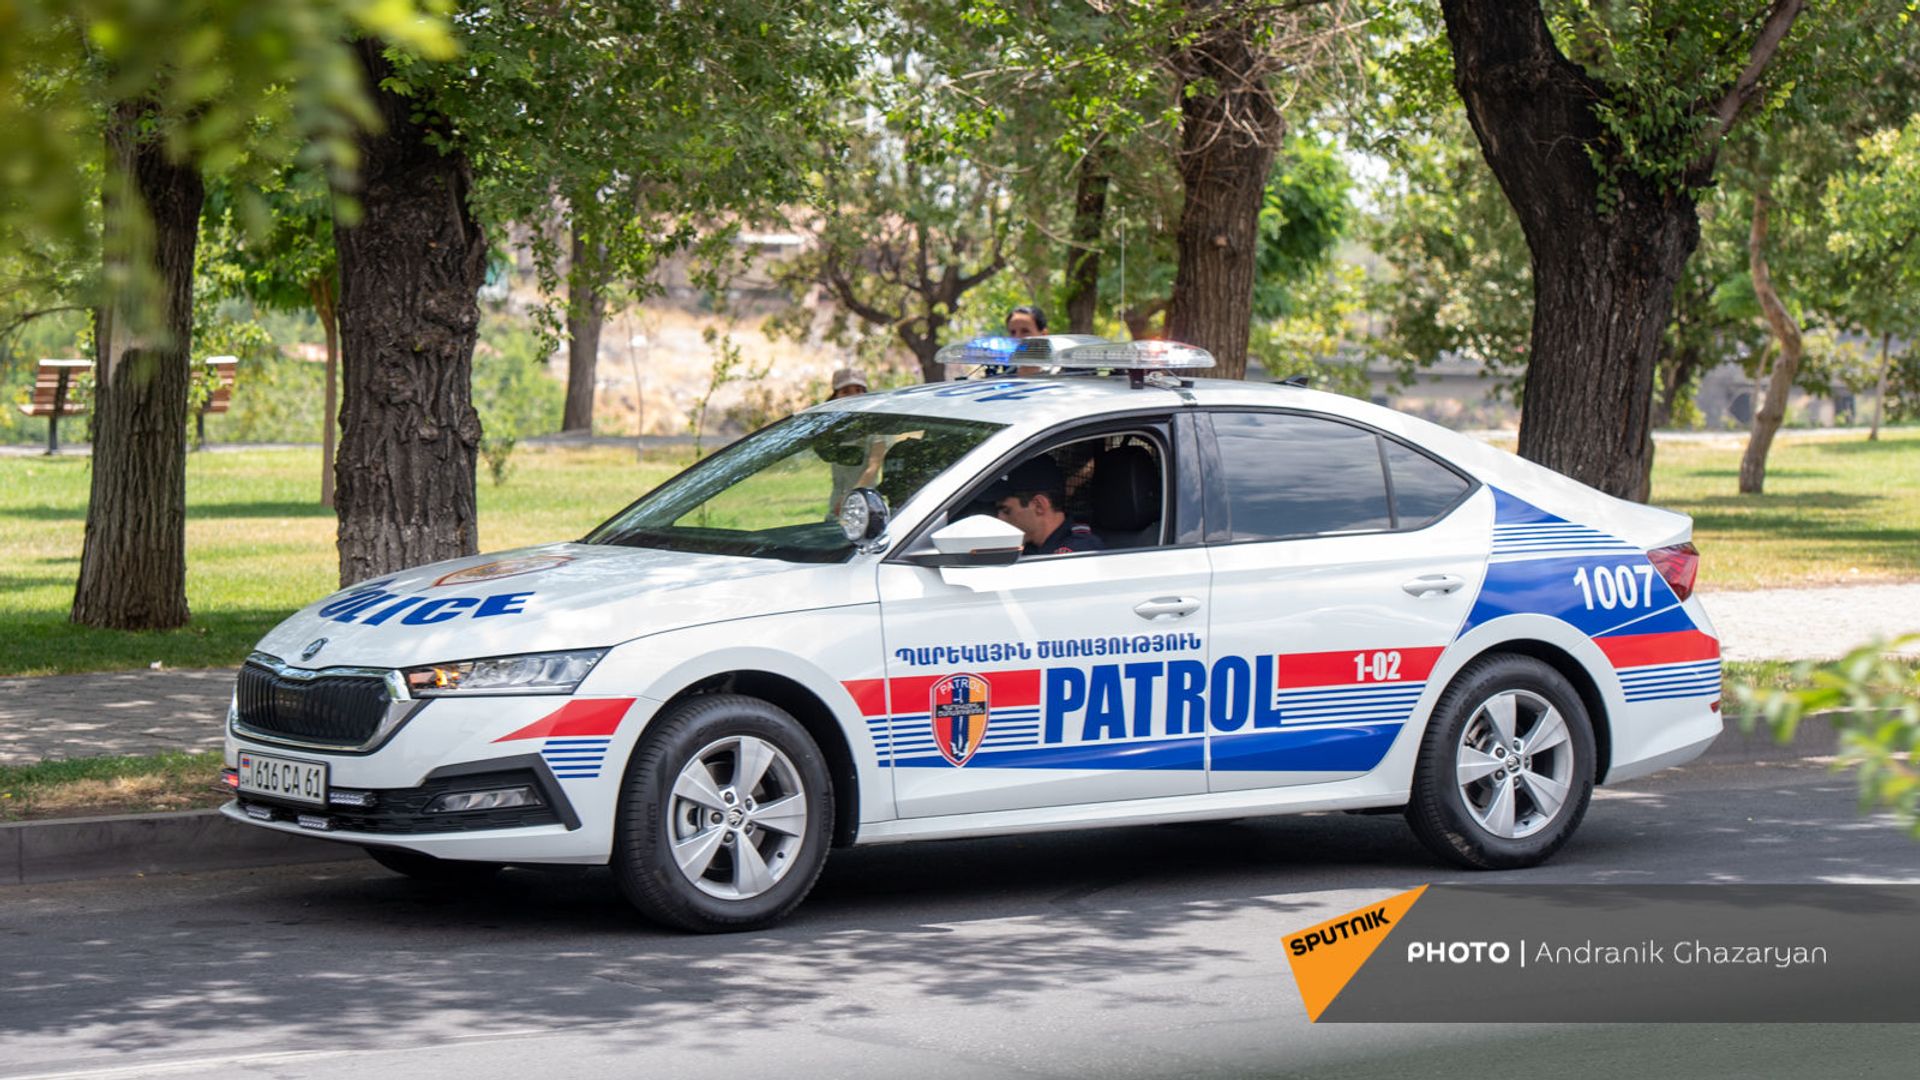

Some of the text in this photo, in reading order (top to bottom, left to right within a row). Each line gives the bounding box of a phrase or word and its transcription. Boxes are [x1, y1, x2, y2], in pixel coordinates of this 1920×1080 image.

[1573, 564, 1654, 611] 1007
[895, 632, 1202, 666] ՊԱՐԵԿԱՅԻՆ ԾԱՌԱՅՈՒԹՅՈՒՆ
[1353, 650, 1402, 682] 1-02
[939, 678, 984, 696] PATROL
[1044, 654, 1282, 744] PATROL
[255, 760, 321, 798] 616 CA 61
